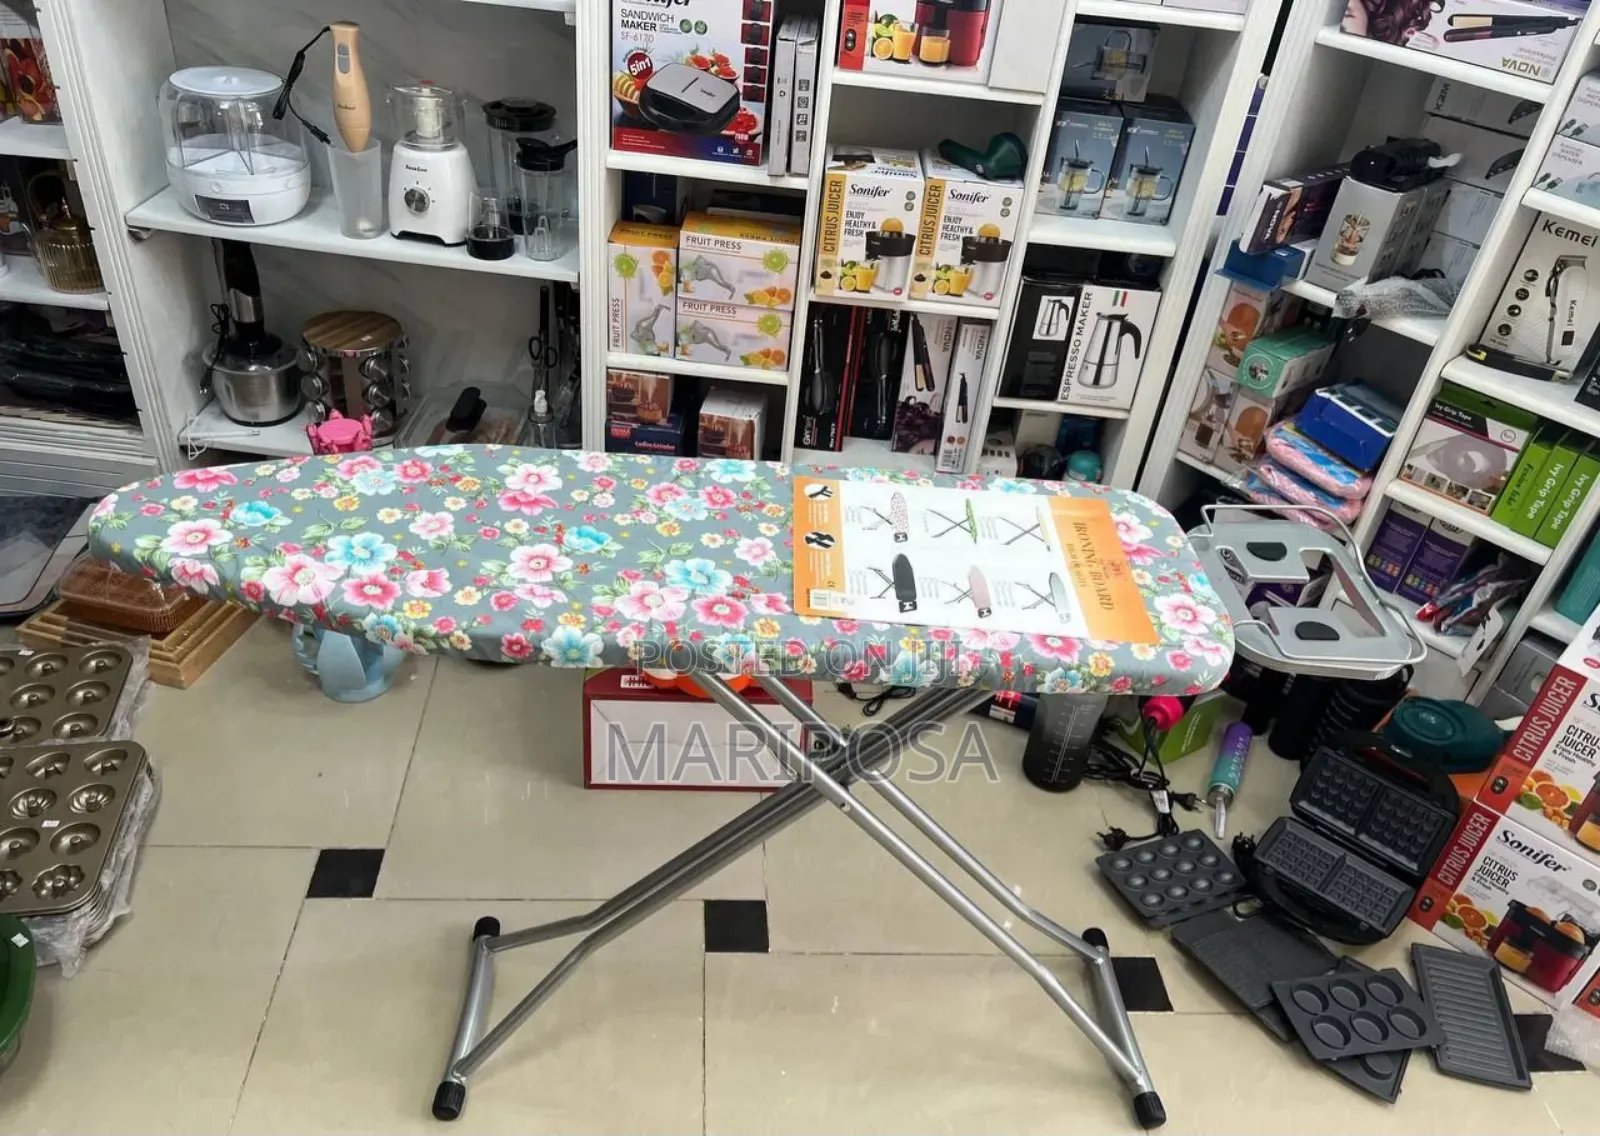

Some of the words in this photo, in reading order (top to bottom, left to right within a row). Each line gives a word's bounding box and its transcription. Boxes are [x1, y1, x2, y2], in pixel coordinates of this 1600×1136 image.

[620, 8, 674, 22] SANDWICH
[621, 20, 656, 32] MAKER
[630, 58, 651, 76] 5in1
[1501, 56, 1541, 76] NOVA
[830, 180, 842, 215] JUICER
[849, 184, 890, 198] Sonifer
[926, 184, 942, 220] JUICER
[950, 189, 990, 204] Sonifer
[845, 220, 871, 228] HEALTHY
[846, 210, 865, 219] ENJOY
[944, 215, 962, 224] ENJOY
[824, 214, 838, 252] CITRUS
[844, 229, 864, 237] FRESH
[920, 219, 936, 256] CITRUS
[940, 232, 960, 241] FRESH
[942, 224, 967, 234] HEALTHY
[1542, 219, 1598, 248] Kemei
[685, 235, 712, 246] FRUIT
[714, 239, 742, 250] PRESS
[612, 298, 620, 322] PRESS
[682, 301, 708, 311] FRUIT
[710, 304, 736, 315] PRESS
[1566, 300, 1577, 326] Kemei
[612, 324, 620, 348] FRUIT
[1061, 339, 1082, 400] ESPRESSO
[1078, 292, 1093, 336] MAKER
[1435, 402, 1443, 410] Ivy
[1444, 406, 1456, 415] Grip
[1458, 412, 1472, 420] Tape
[1549, 463, 1565, 477] Ivy
[1575, 474, 1590, 487] Ivy
[1537, 475, 1556, 498] Grip
[1562, 485, 1581, 509] Grip
[1527, 496, 1545, 519] Tape
[1550, 506, 1570, 530] Tape
[1073, 521, 1097, 568] IRONING
[1090, 571, 1114, 611] BOARD
[1512, 720, 1550, 762] CITRUS
[1540, 675, 1577, 722] JUICER
[1559, 735, 1596, 759] JUICER
[1437, 845, 1471, 886] CITRUS
[1458, 812, 1492, 852] JUICER
[1497, 829, 1567, 872] Sonifer
[1477, 865, 1510, 888] JUICER
[1483, 856, 1518, 881] CITRUS
